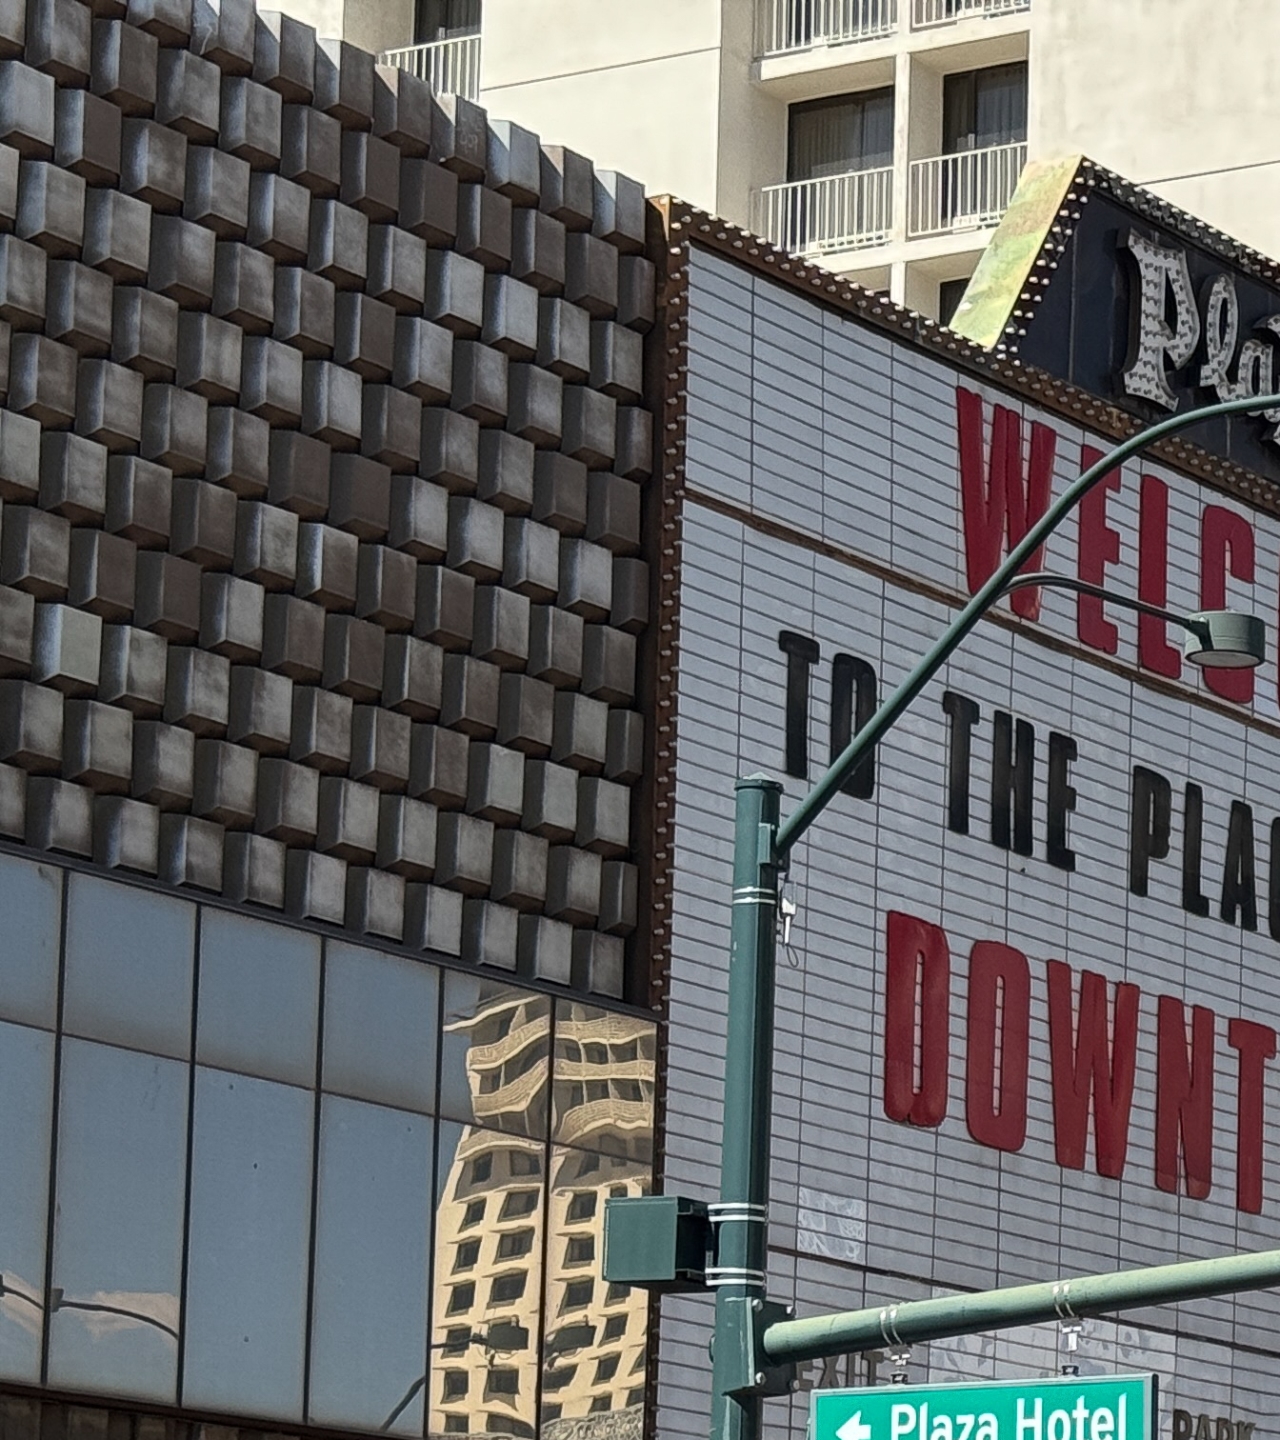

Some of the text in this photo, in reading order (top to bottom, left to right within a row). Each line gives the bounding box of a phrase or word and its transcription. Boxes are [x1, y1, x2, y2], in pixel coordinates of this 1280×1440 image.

[779, 629, 877, 799] TO
[943, 691, 1078, 872] THE
[796, 1350, 884, 1391] EXIT
